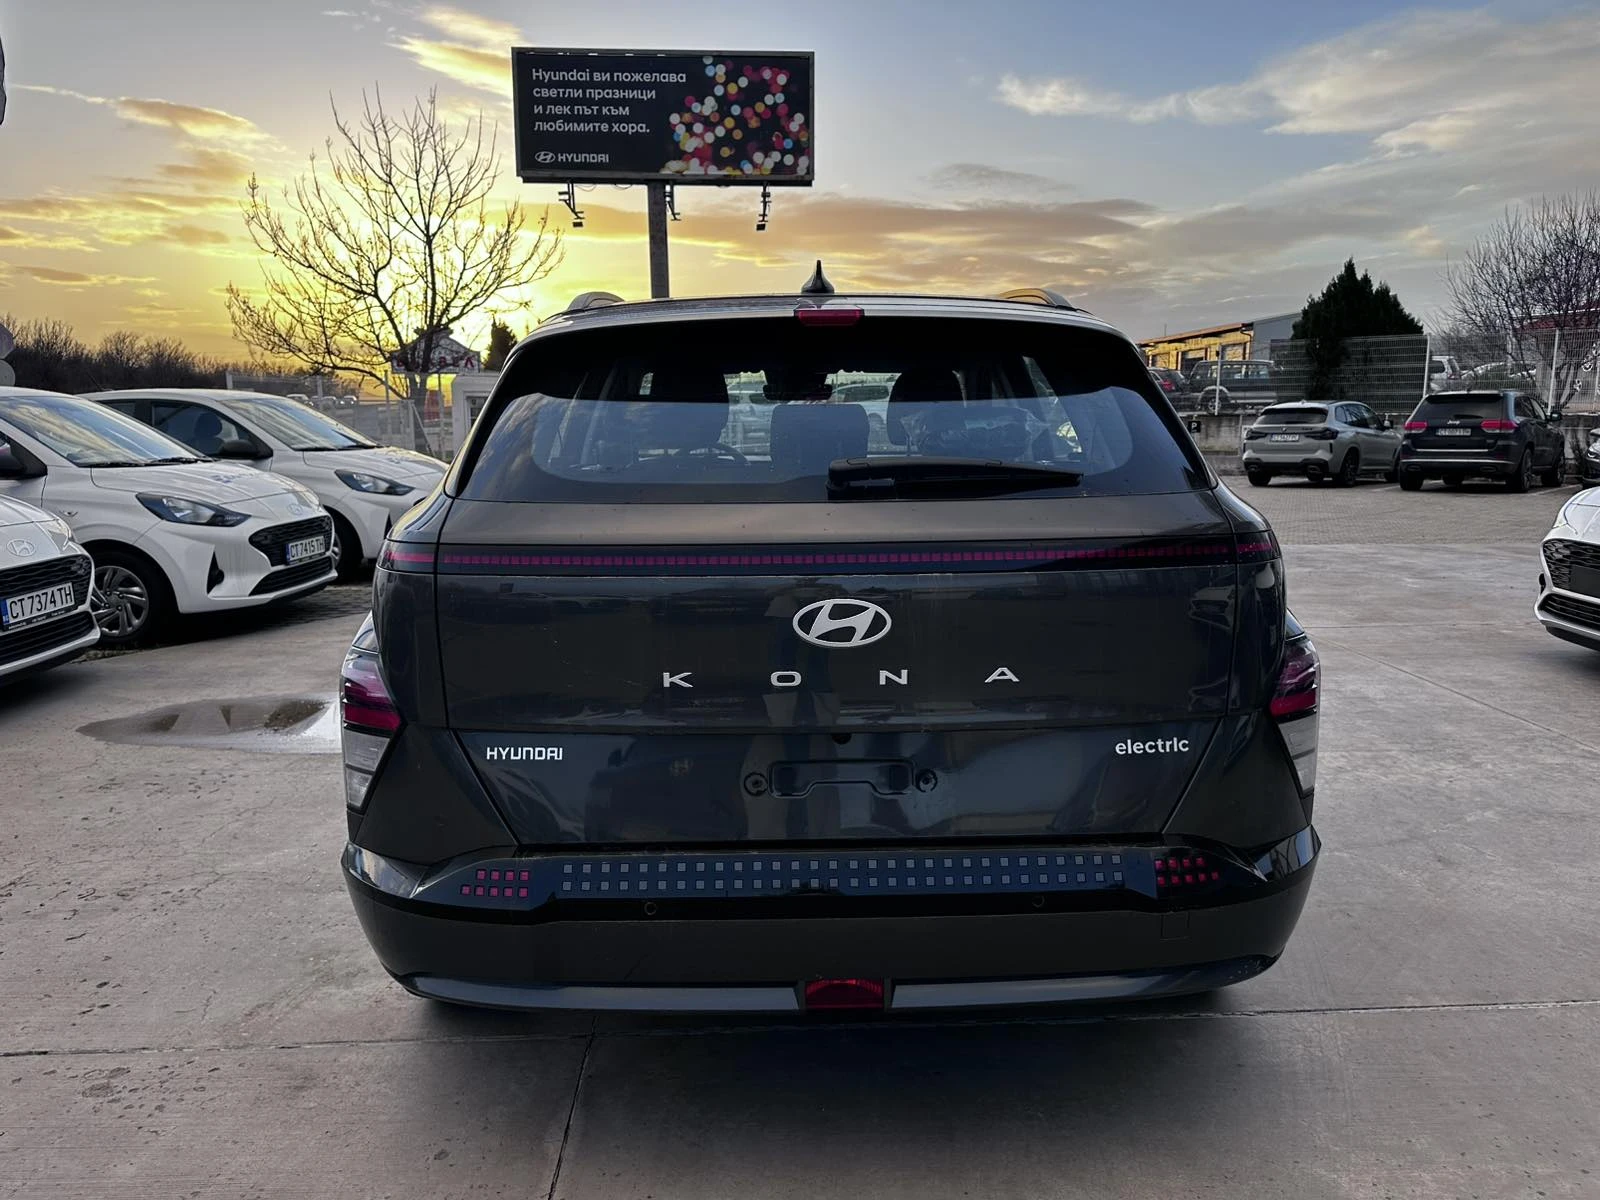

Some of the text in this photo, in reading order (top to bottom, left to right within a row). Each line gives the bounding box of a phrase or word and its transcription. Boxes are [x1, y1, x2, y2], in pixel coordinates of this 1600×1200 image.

[532, 68, 686, 82] Hyundai ви пожелава
[532, 88, 656, 100] светли празници
[534, 104, 630, 116] и лек път към
[534, 120, 650, 134] любимите хора.
[558, 153, 610, 162] HYUNDAI
[1116, 738, 1189, 754] electric
[487, 747, 562, 760] HYUNDAI
